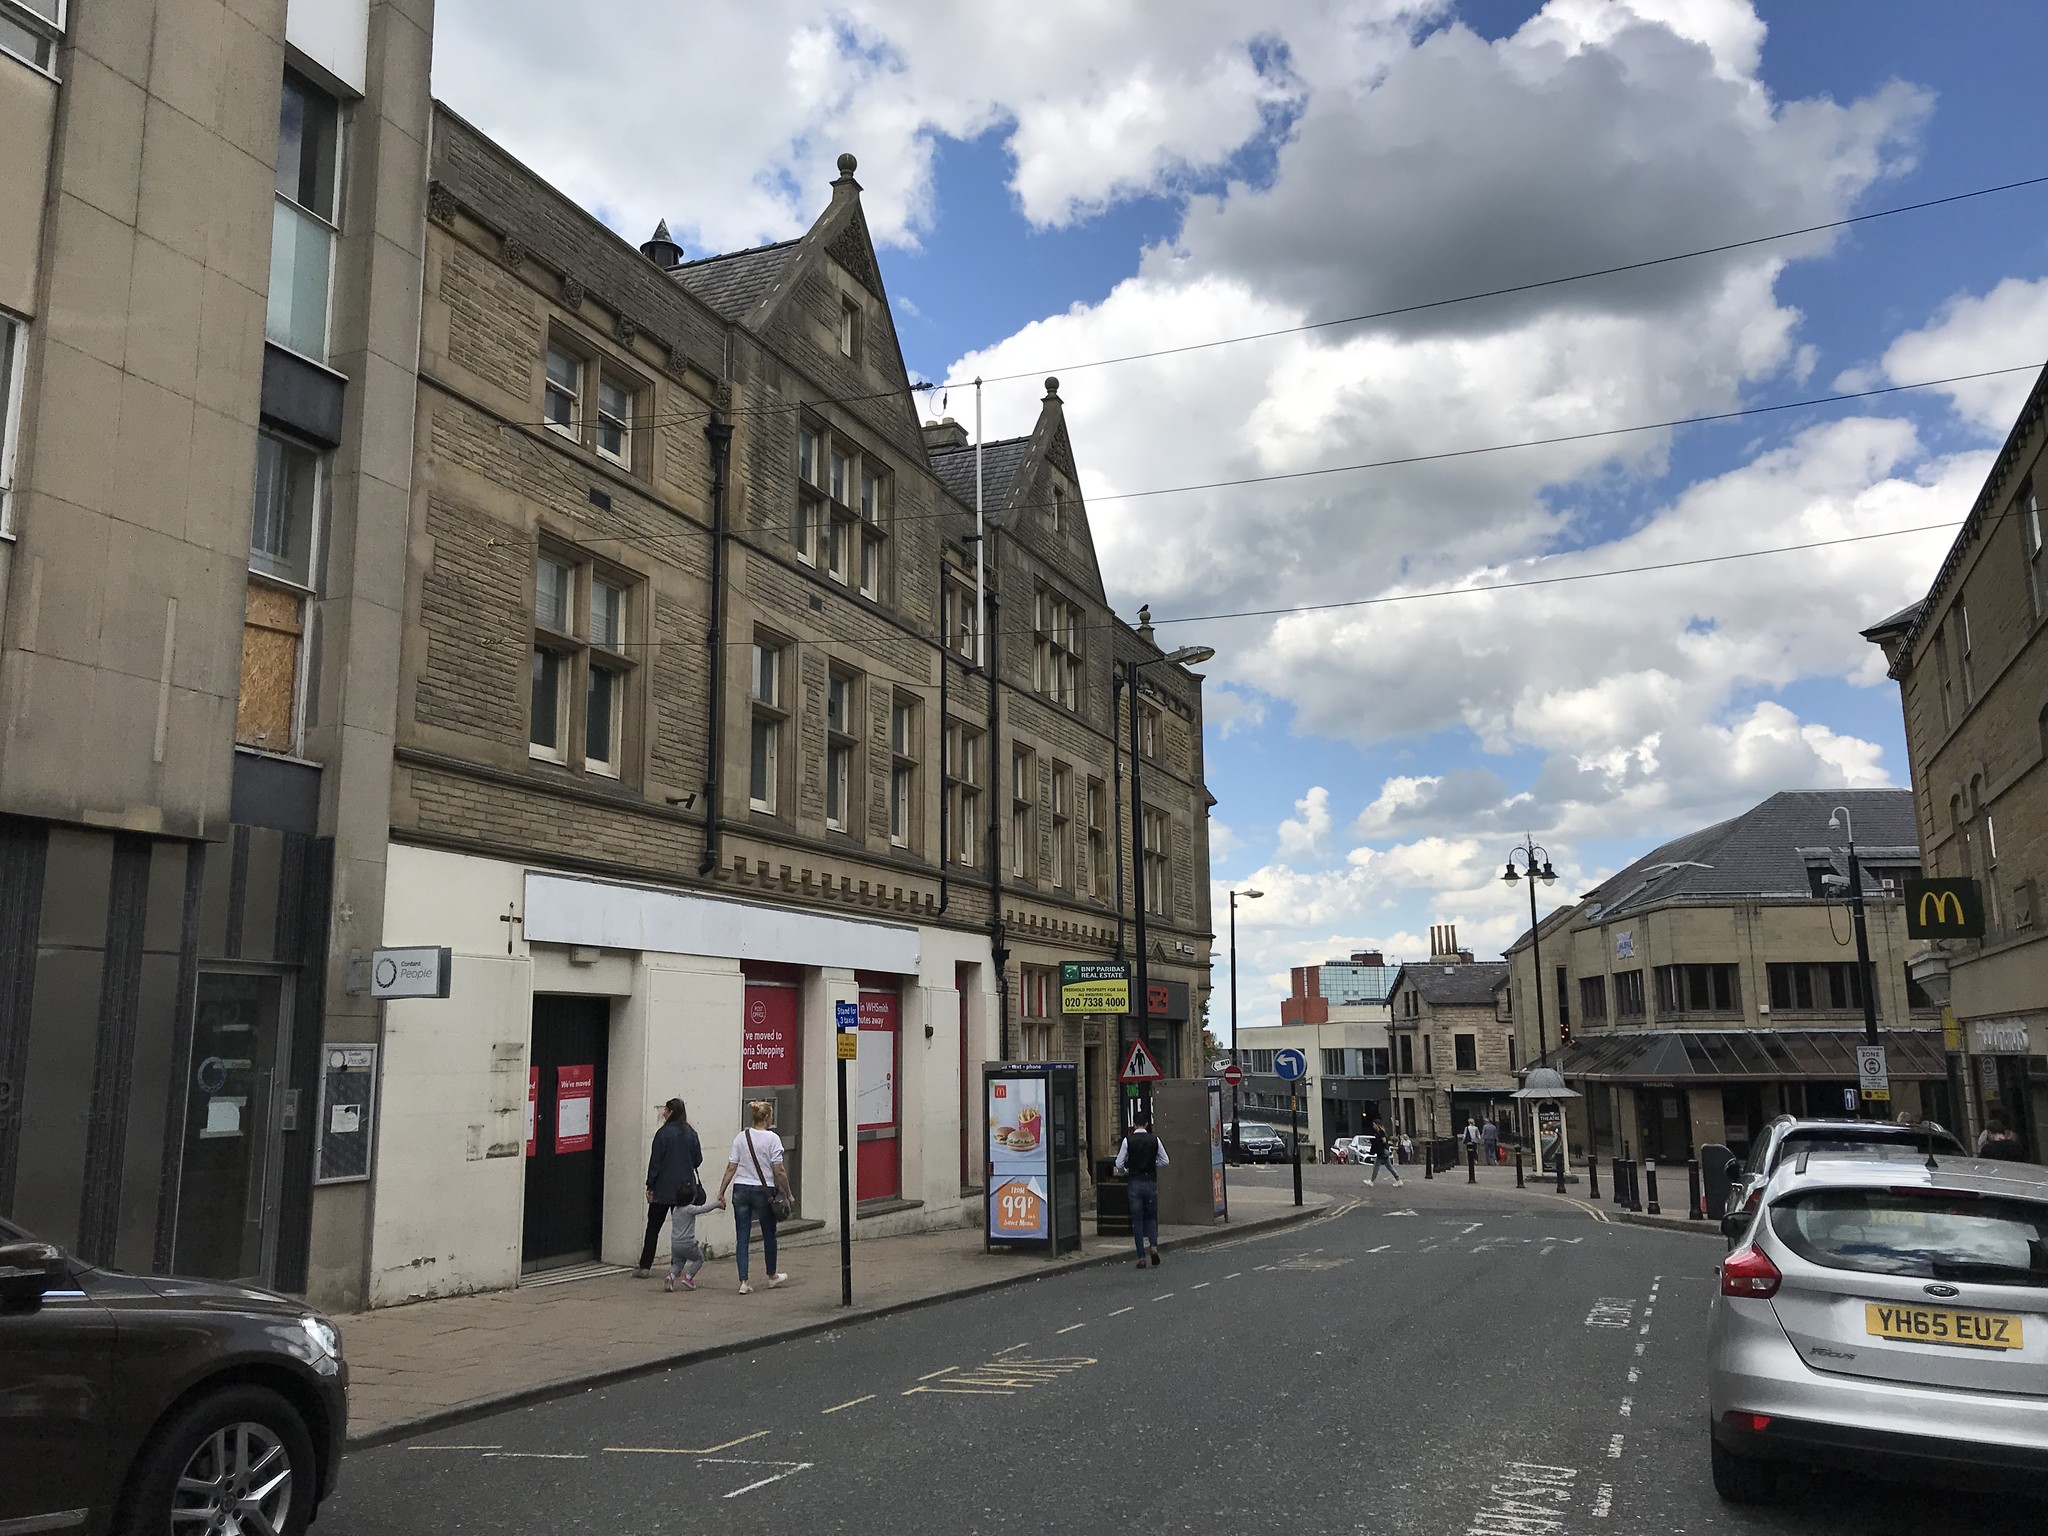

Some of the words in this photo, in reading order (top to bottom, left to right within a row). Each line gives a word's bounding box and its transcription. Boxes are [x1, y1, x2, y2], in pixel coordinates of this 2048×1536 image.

[400, 968, 432, 979] People
[866, 1002, 889, 1012] WHSmith
[1065, 997, 1081, 1007] 020
[1083, 997, 1103, 1007] 7338
[1105, 997, 1126, 1007] 4000
[837, 1007, 850, 1015] Stand
[844, 1016, 854, 1024] taxis
[859, 1016, 871, 1024] nutes
[872, 1017, 884, 1027] away
[754, 1029, 775, 1040] moved
[776, 1031, 782, 1040] to
[757, 1044, 785, 1058] Shopping
[747, 1059, 768, 1070] Centre
[561, 1080, 575, 1088] We've
[576, 1079, 591, 1087] moved
[1877, 1308, 1948, 1336] YH65
[1956, 1315, 2010, 1342] EUZ
